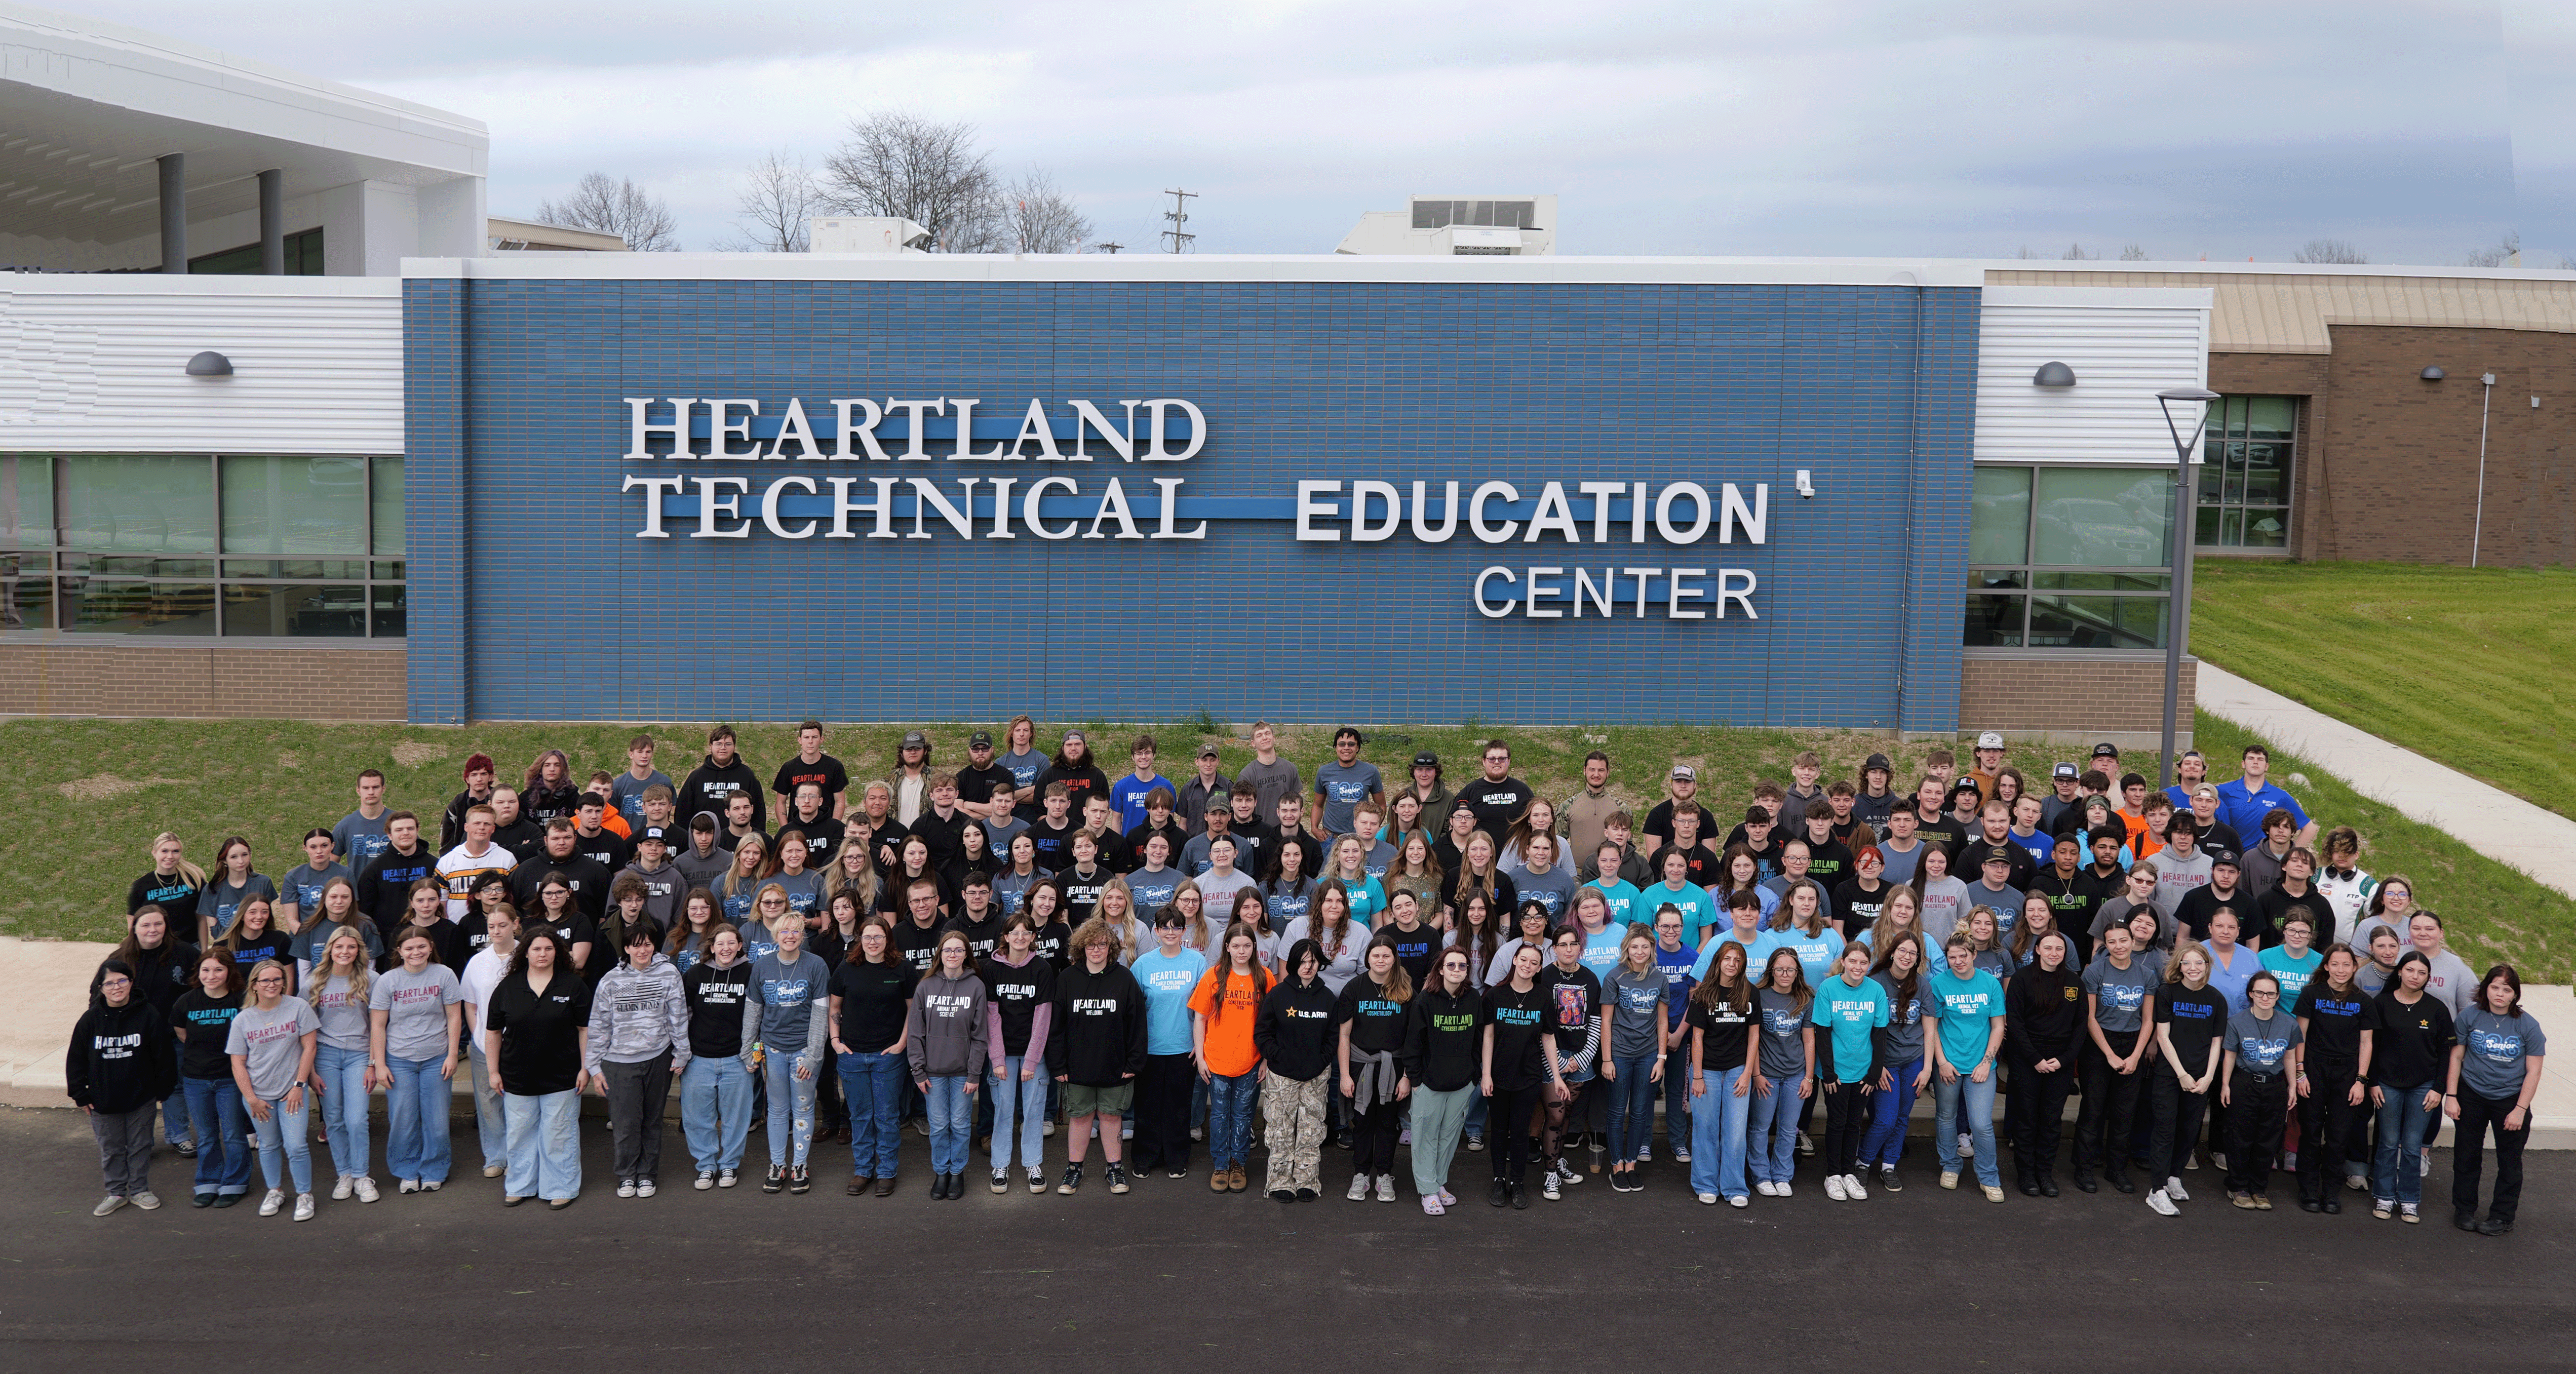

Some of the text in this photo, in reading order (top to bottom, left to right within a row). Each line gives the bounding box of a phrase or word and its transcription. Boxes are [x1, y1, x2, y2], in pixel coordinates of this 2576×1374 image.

[623, 397, 1206, 462] HEARTLAND
[622, 475, 1768, 543] TECHNICAL EDUCATION
[1475, 566, 1758, 618] CENTER
[793, 775, 825, 785] HEARTLAND
[1016, 770, 1034, 779] Senior
[1257, 775, 1286, 788] HEARTLAND
[704, 783, 740, 793] HEARTLAND
[1128, 793, 1148, 802] HEART
[1483, 793, 1516, 803] HEARTLAND
[1914, 831, 1952, 841] HILLSDALE
[1810, 860, 1839, 871] ARTLAND
[2163, 872, 2204, 885] HEARTLAND
[1146, 889, 1169, 897] Senior
[1203, 892, 1237, 903] HEARTLAN
[790, 898, 813, 907] Senior
[1281, 901, 1306, 910] Senior
[1852, 902, 1883, 912] HEARTLAN
[1996, 913, 2012, 921] enior
[235, 946, 275, 959] EARTLAND
[1397, 943, 1427, 954] ARTLAND
[1747, 958, 1768, 969] TLAND
[1659, 965, 1692, 974] EARTLAND
[1151, 970, 1191, 985] HEARTLAND
[2272, 970, 2311, 982] HEARTLAN
[394, 985, 439, 1002] HEARTLAND
[699, 983, 744, 996] HEARTLAND
[777, 986, 804, 996] Senior
[996, 984, 1035, 998] HEARTLAND
[1632, 994, 1657, 1004] Senior
[1945, 994, 1988, 1006] HEARTLAND
[2117, 991, 2142, 1000] Senior
[617, 1003, 638, 1012] GLAMIS
[926, 995, 970, 1009] HEARTLAND
[1073, 999, 1116, 1012] HEARTLAND
[1358, 1001, 1401, 1014] HEARTLAND
[1832, 1001, 1875, 1013] HEARTLAND
[2316, 999, 2360, 1014] HEARTLAND
[1708, 1002, 1752, 1015] HEARTD
[2173, 1002, 2213, 1016] HEARTLAND
[188, 1008, 238, 1022] HEARTLAND
[1497, 1008, 1541, 1023] HEARTLAND
[1434, 1014, 1473, 1028] HEARTLAND
[1776, 1016, 1801, 1026] Senior
[247, 1020, 296, 1043] HEARTLAND
[2258, 1045, 2284, 1054] Senior
[2486, 1040, 2516, 1050] Senior
